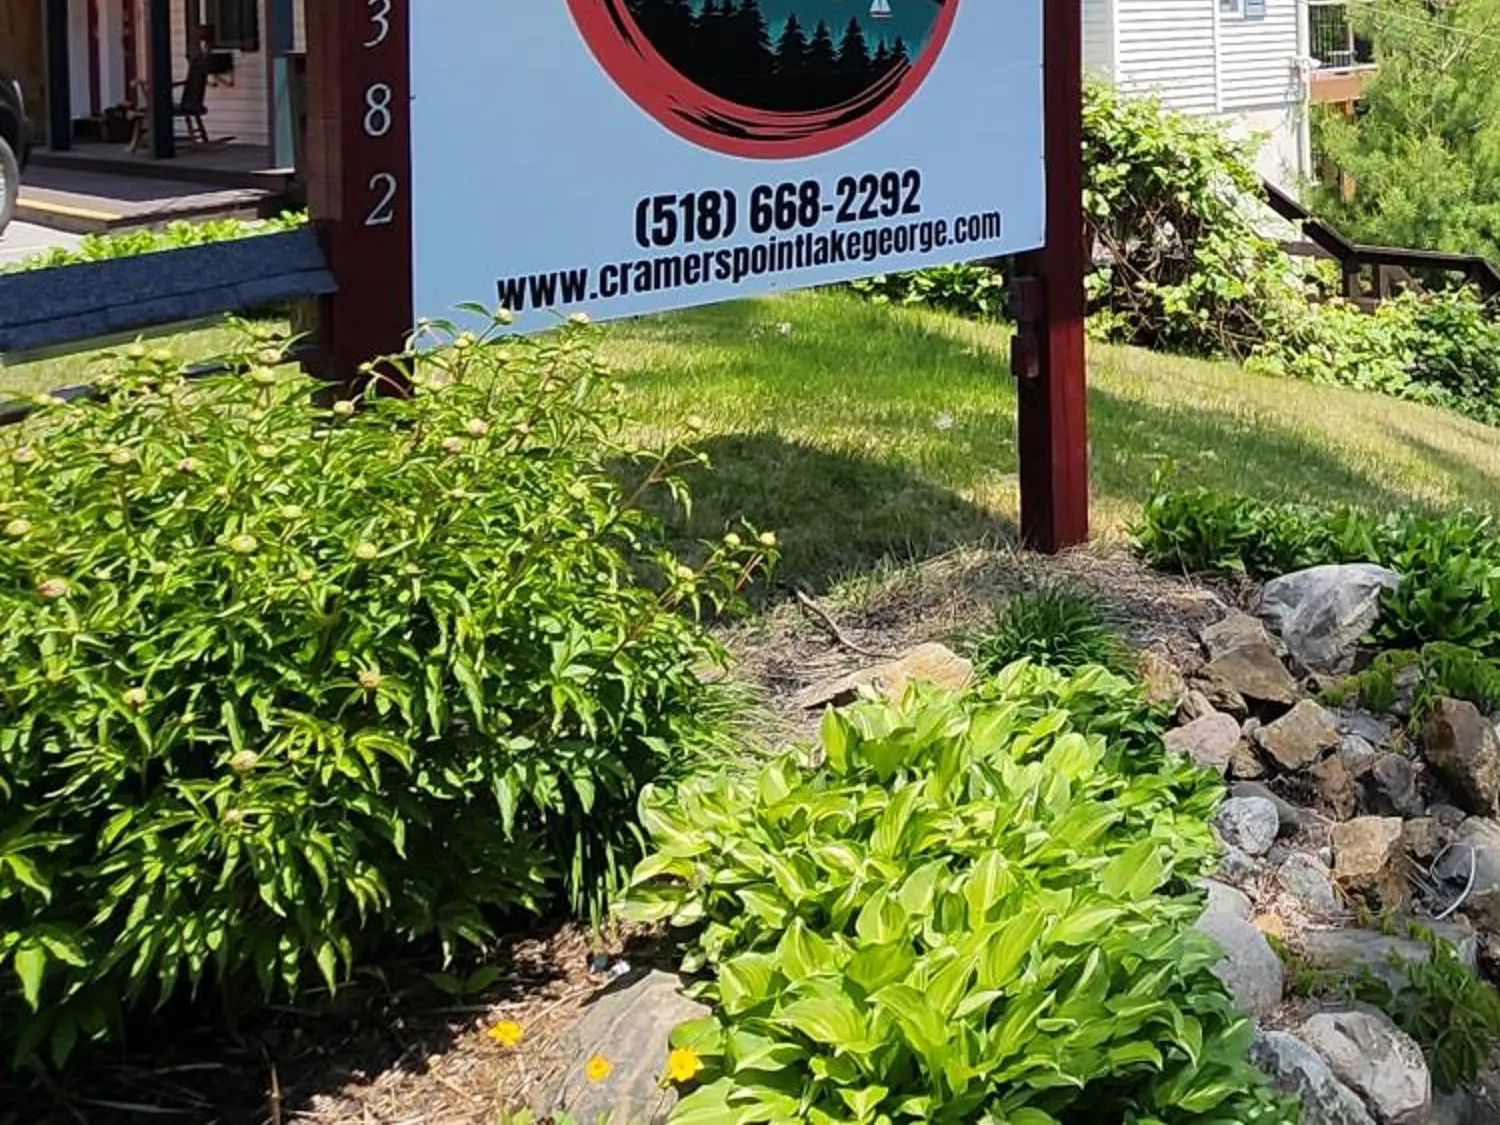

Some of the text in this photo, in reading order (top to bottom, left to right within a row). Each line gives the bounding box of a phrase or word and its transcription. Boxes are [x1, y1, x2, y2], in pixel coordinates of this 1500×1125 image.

[635, 169, 921, 248] (518) 668-2292
[497, 209, 1001, 312] www.cramerspointlakegeorge.com
